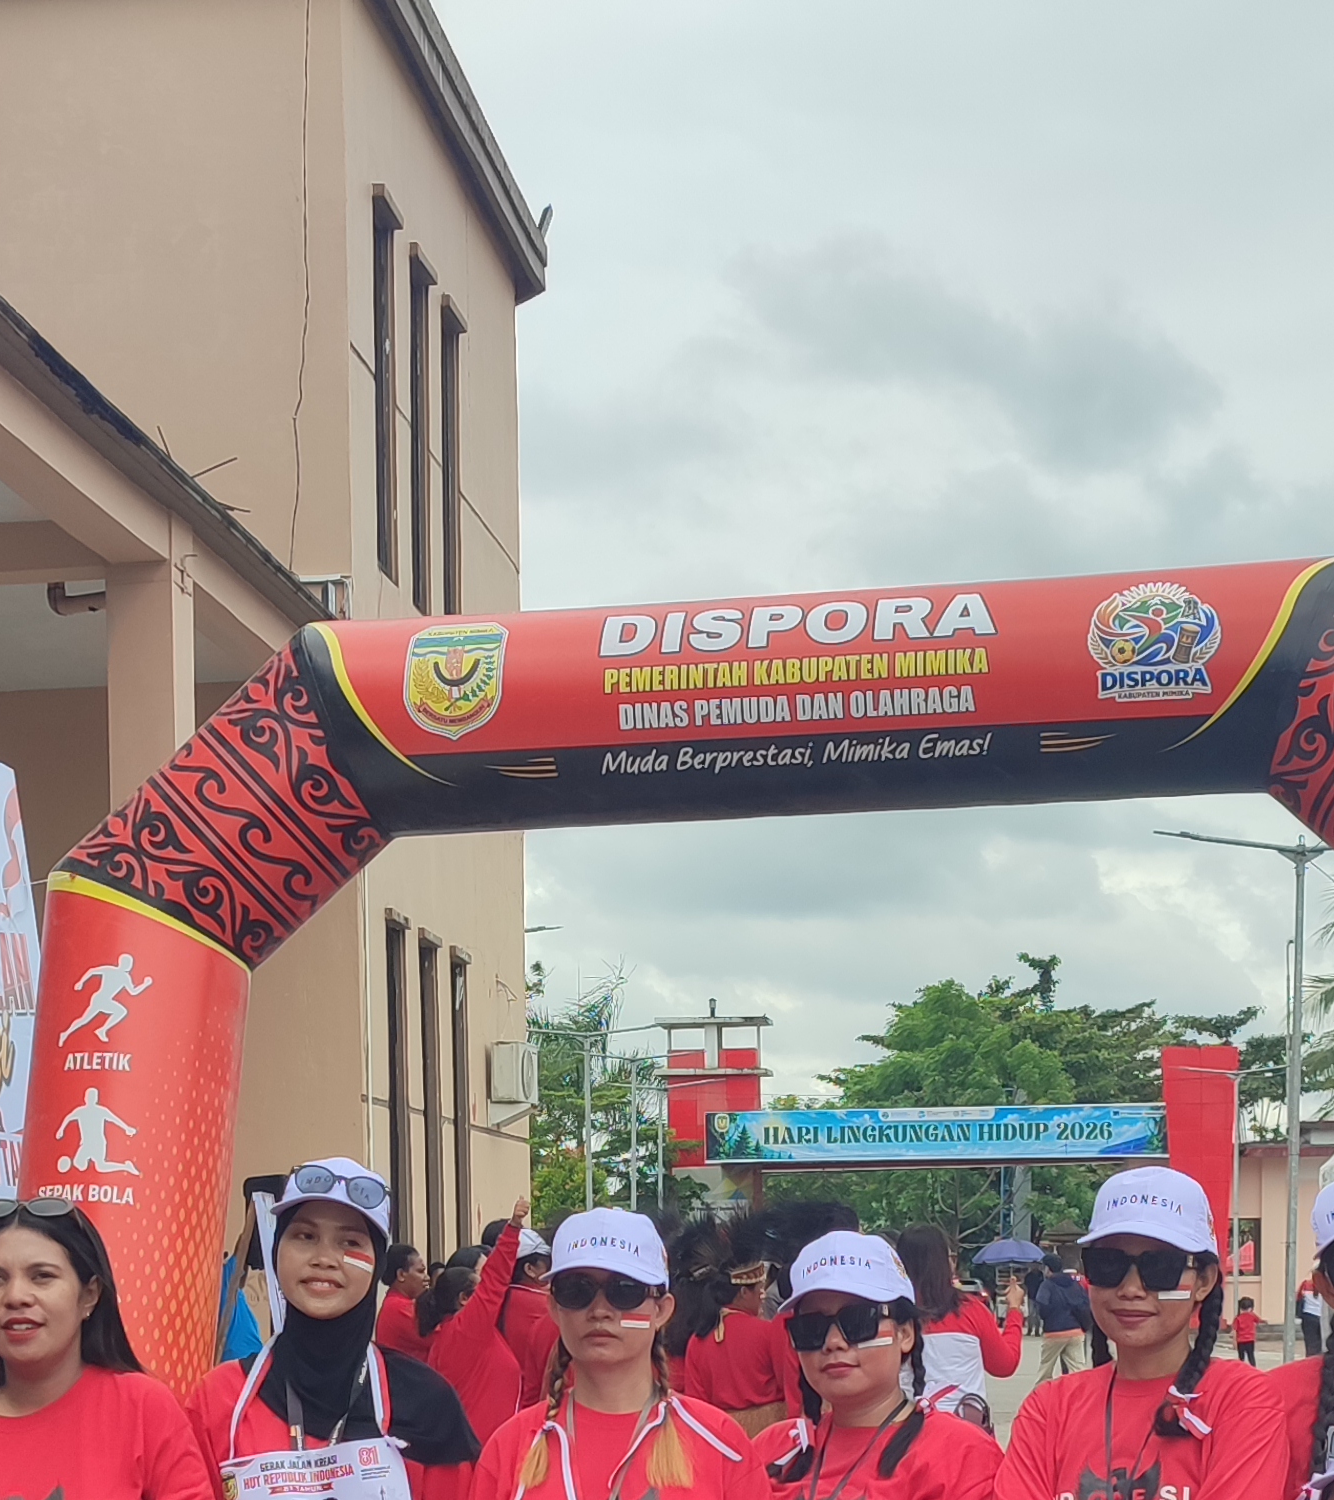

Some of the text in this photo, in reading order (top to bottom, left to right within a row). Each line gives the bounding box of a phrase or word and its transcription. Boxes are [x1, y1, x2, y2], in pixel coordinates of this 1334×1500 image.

[599, 592, 998, 657] DISPORA
[603, 647, 989, 694] PEMERINTAH KABUPATEN MIMIKA
[1101, 667, 1209, 692] DISPORA
[618, 685, 976, 730] DINAS PEMUDA DAN OLAHRAGA
[601, 731, 993, 775] Muda Berprestasi, Mimika Emas!
[64, 1051, 132, 1073] ATLETIK
[763, 1120, 1113, 1146] HARI LINGKUNGAN HIDUP 2026
[38, 1184, 135, 1206] SEPAK BOLA
[1106, 1194, 1183, 1216] INDONESIA
[567, 1236, 641, 1257] INDONESIA
[801, 1255, 872, 1279] INDONESIA
[358, 1445, 381, 1466] 81
